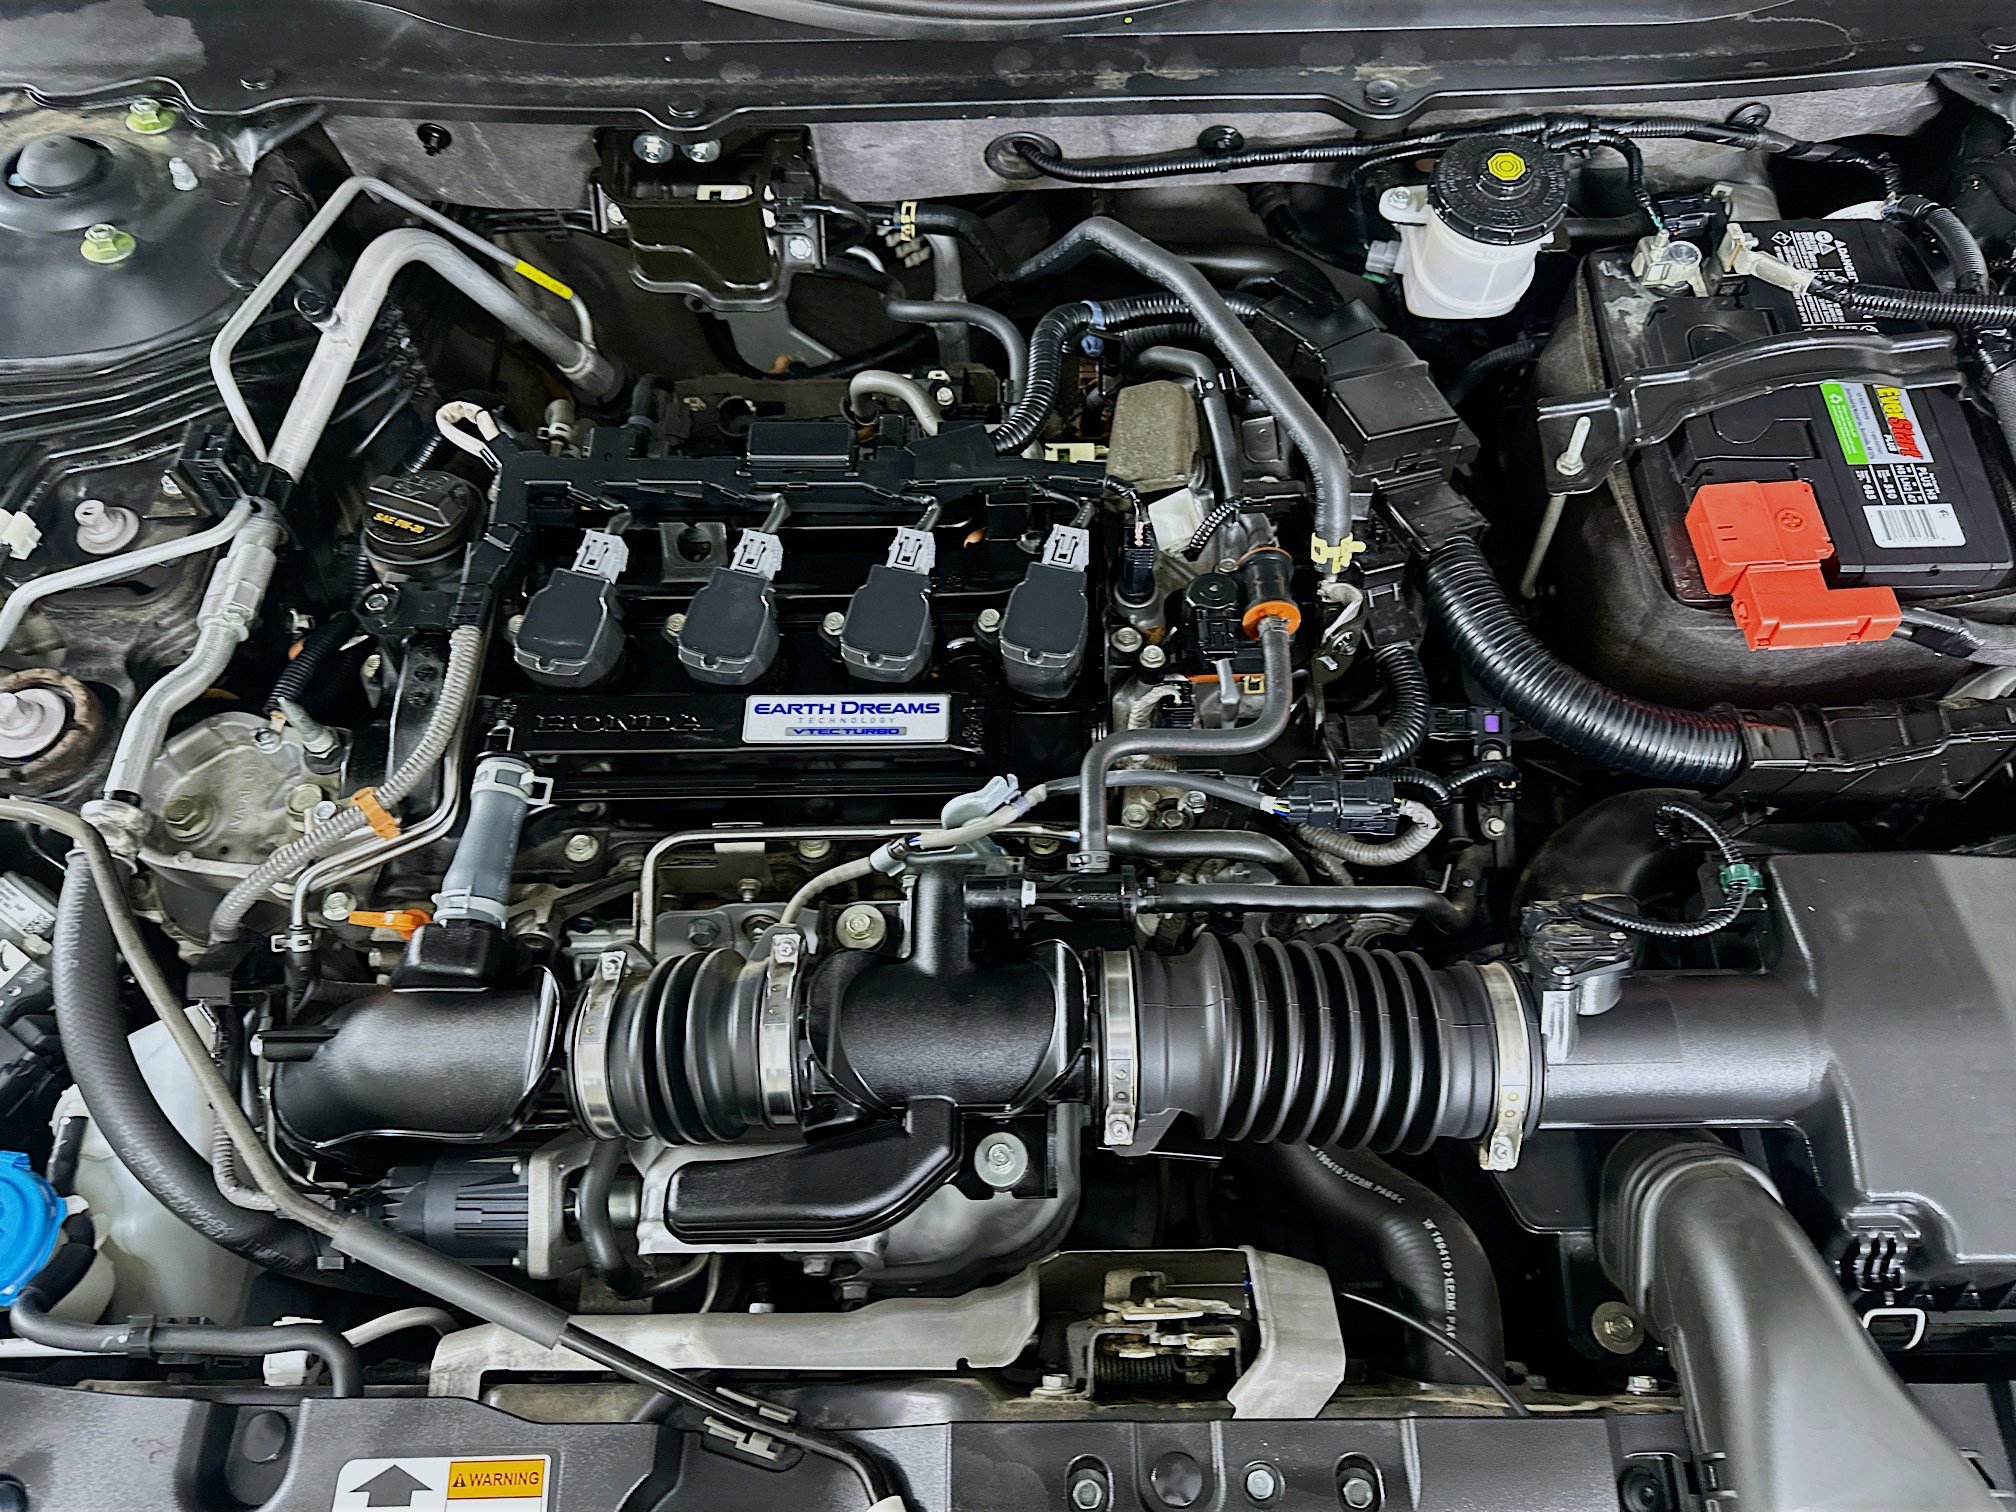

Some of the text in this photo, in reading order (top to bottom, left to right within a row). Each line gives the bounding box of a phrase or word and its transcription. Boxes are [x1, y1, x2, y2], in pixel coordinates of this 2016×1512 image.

[1883, 434, 1898, 452] PLUS
[1916, 466, 1932, 488] PLUS
[754, 701, 941, 715] EARTH DREAMS
[533, 713, 715, 733] HONDA
[793, 727, 900, 735] VTEC TURBO
[469, 1471, 540, 1487] WARNING
